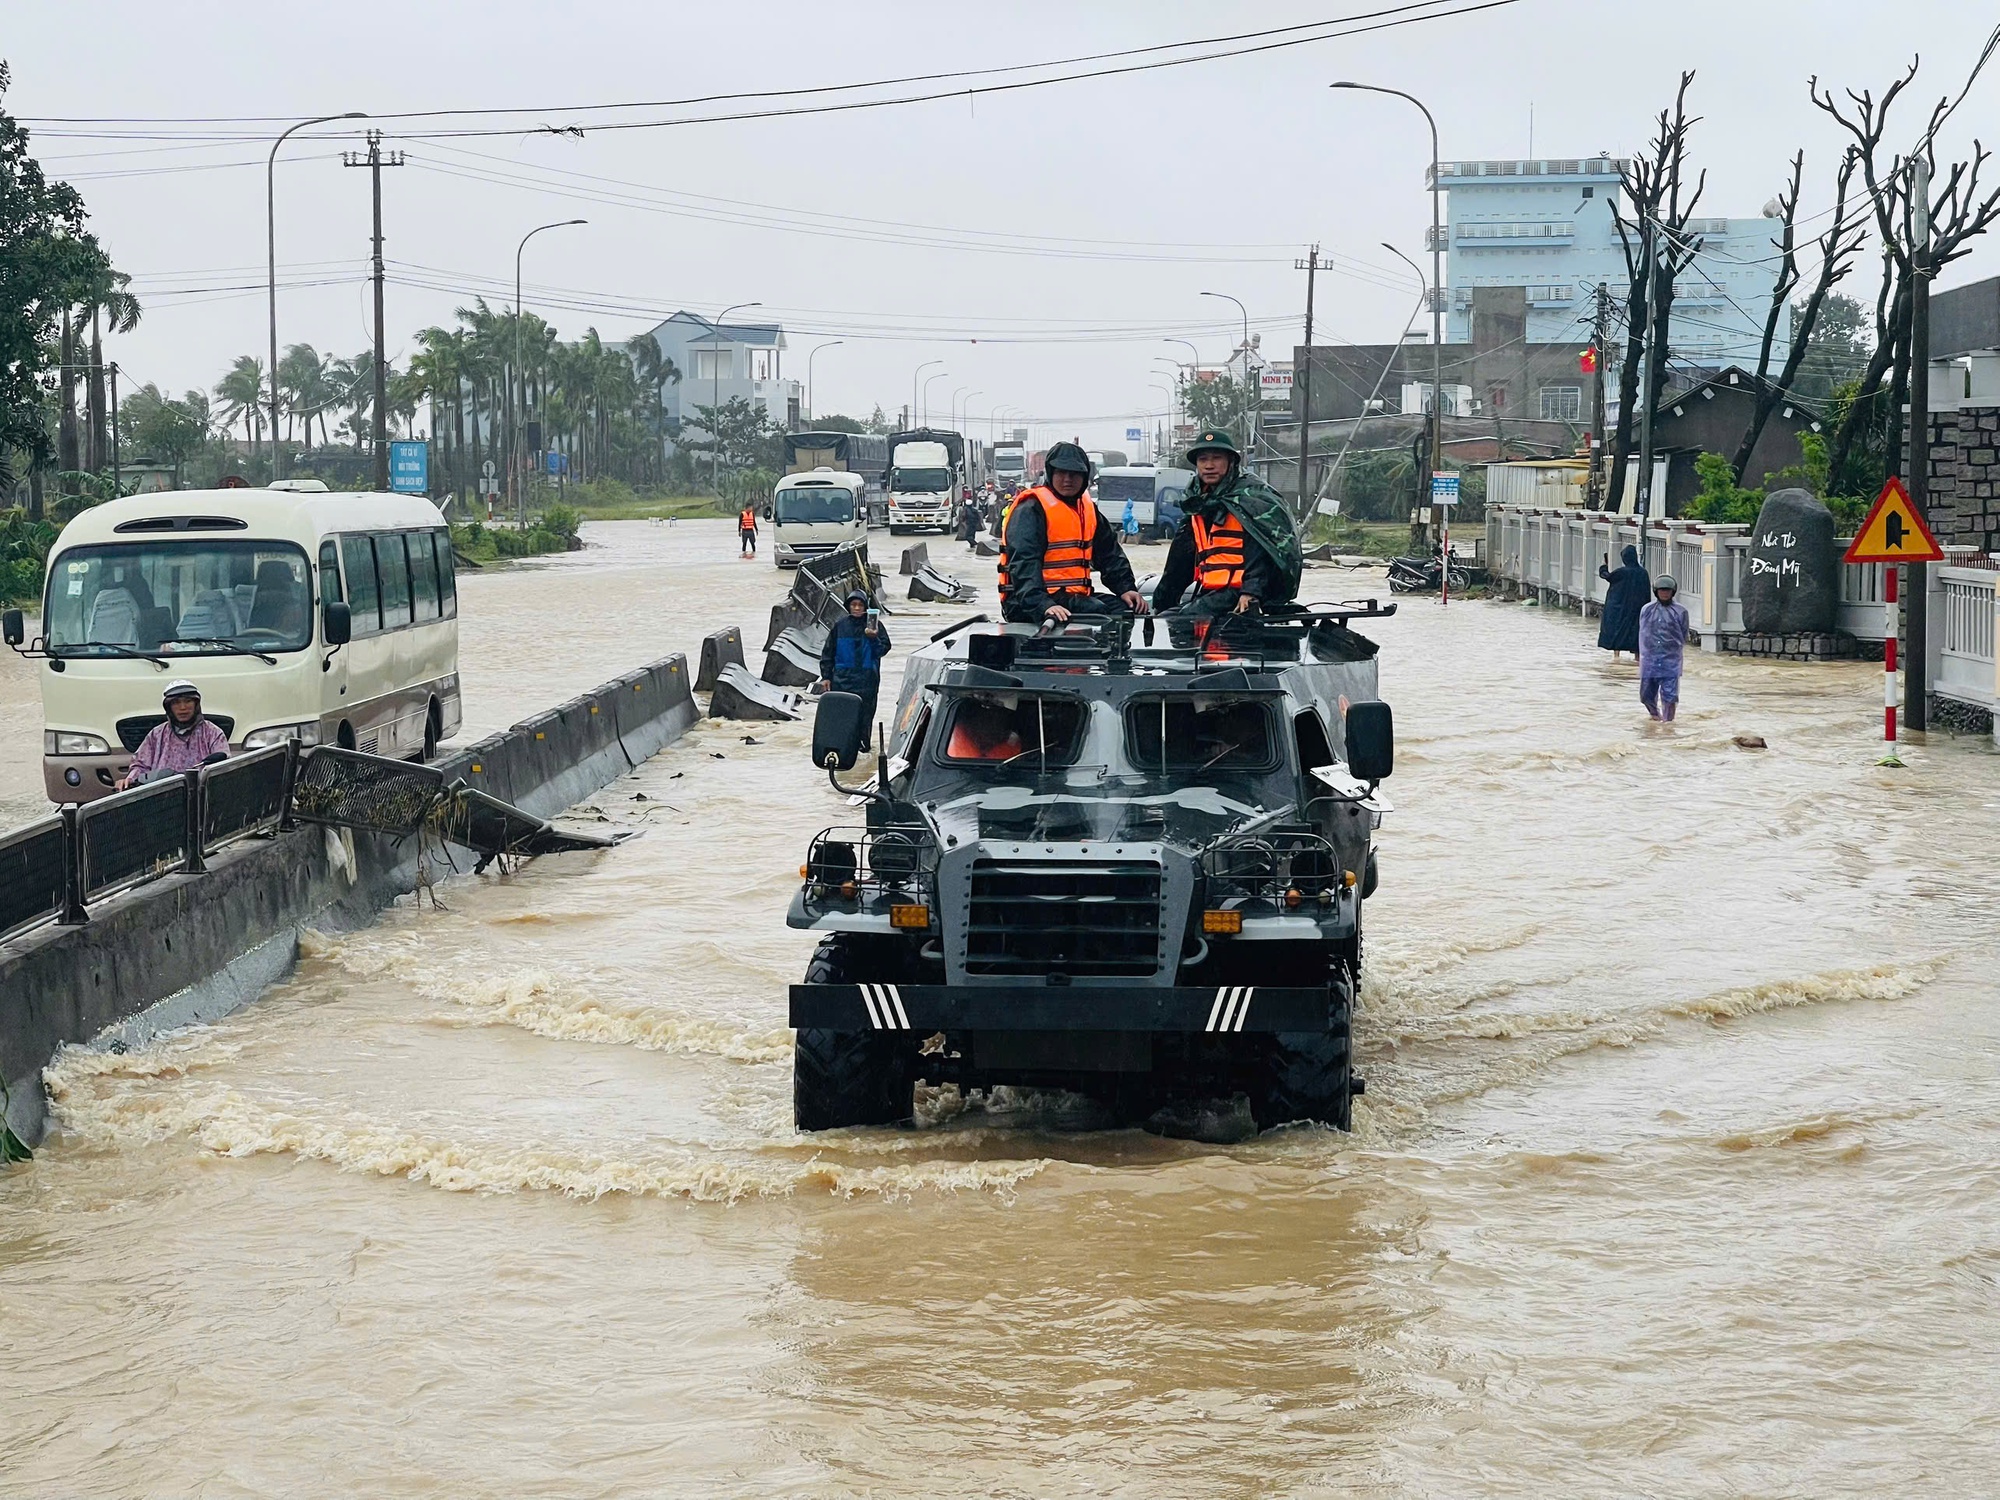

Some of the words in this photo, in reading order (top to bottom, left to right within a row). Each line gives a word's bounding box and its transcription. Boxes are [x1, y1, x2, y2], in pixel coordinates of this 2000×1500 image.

[1262, 376, 1281, 384] MINH
[1750, 557, 1781, 588] Đông
[1782, 557, 1802, 588] Mỹ
